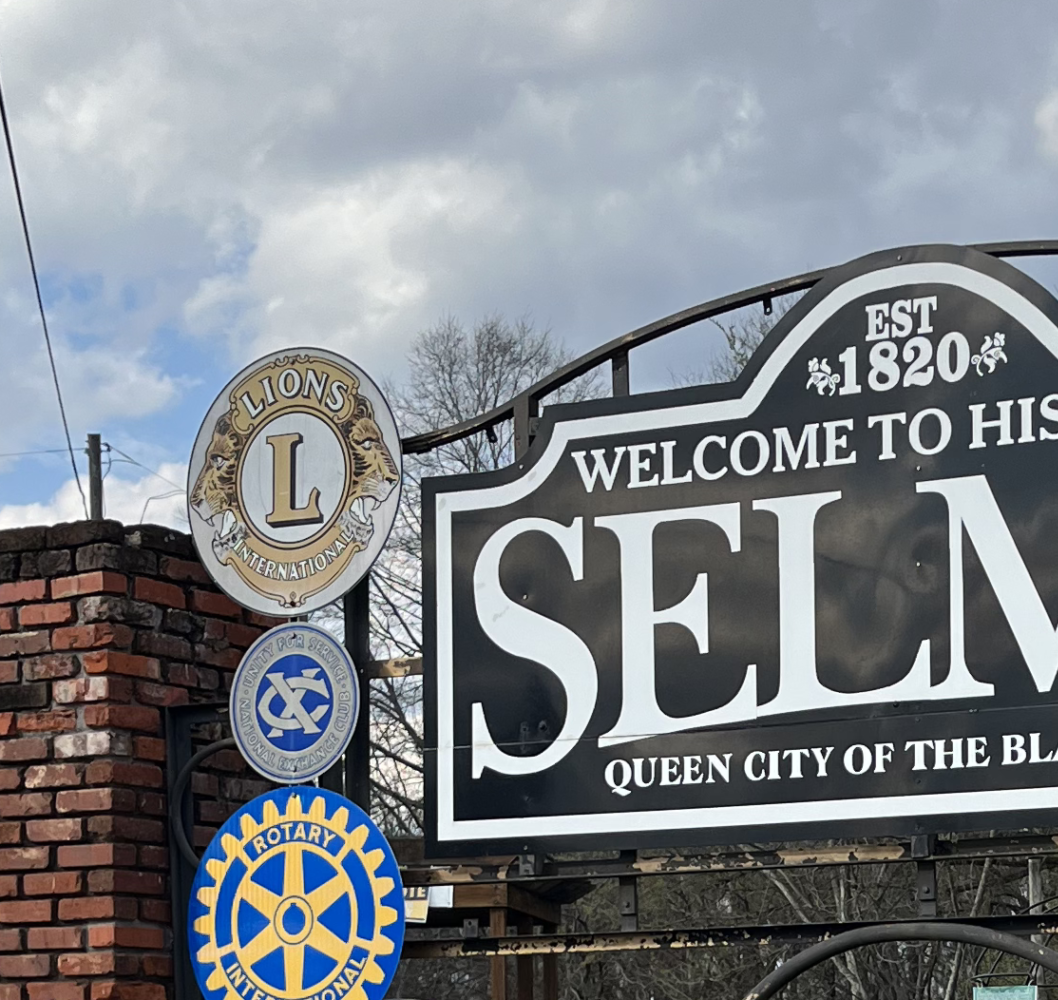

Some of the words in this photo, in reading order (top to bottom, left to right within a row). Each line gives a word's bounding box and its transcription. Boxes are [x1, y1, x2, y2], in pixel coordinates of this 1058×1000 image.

[865, 295, 937, 342] EST
[838, 331, 970, 396] 1820
[239, 367, 349, 419] LIONS
[570, 418, 857, 493] WELCOME
[867, 407, 952, 460] TO
[266, 432, 323, 528] L
[232, 530, 355, 581] INTERNATIONAL
[243, 642, 275, 688] UNITY
[276, 634, 305, 651] FOR
[307, 637, 347, 684] SERVICE
[239, 697, 276, 768] NATIONAL
[277, 733, 340, 772] EXCHANGE
[334, 690, 350, 733] CLUB
[604, 753, 733, 796] QUEEN
[743, 746, 834, 781] CITY
[843, 742, 895, 775] OF
[904, 736, 991, 771] THE
[252, 822, 337, 854] ROTARY
